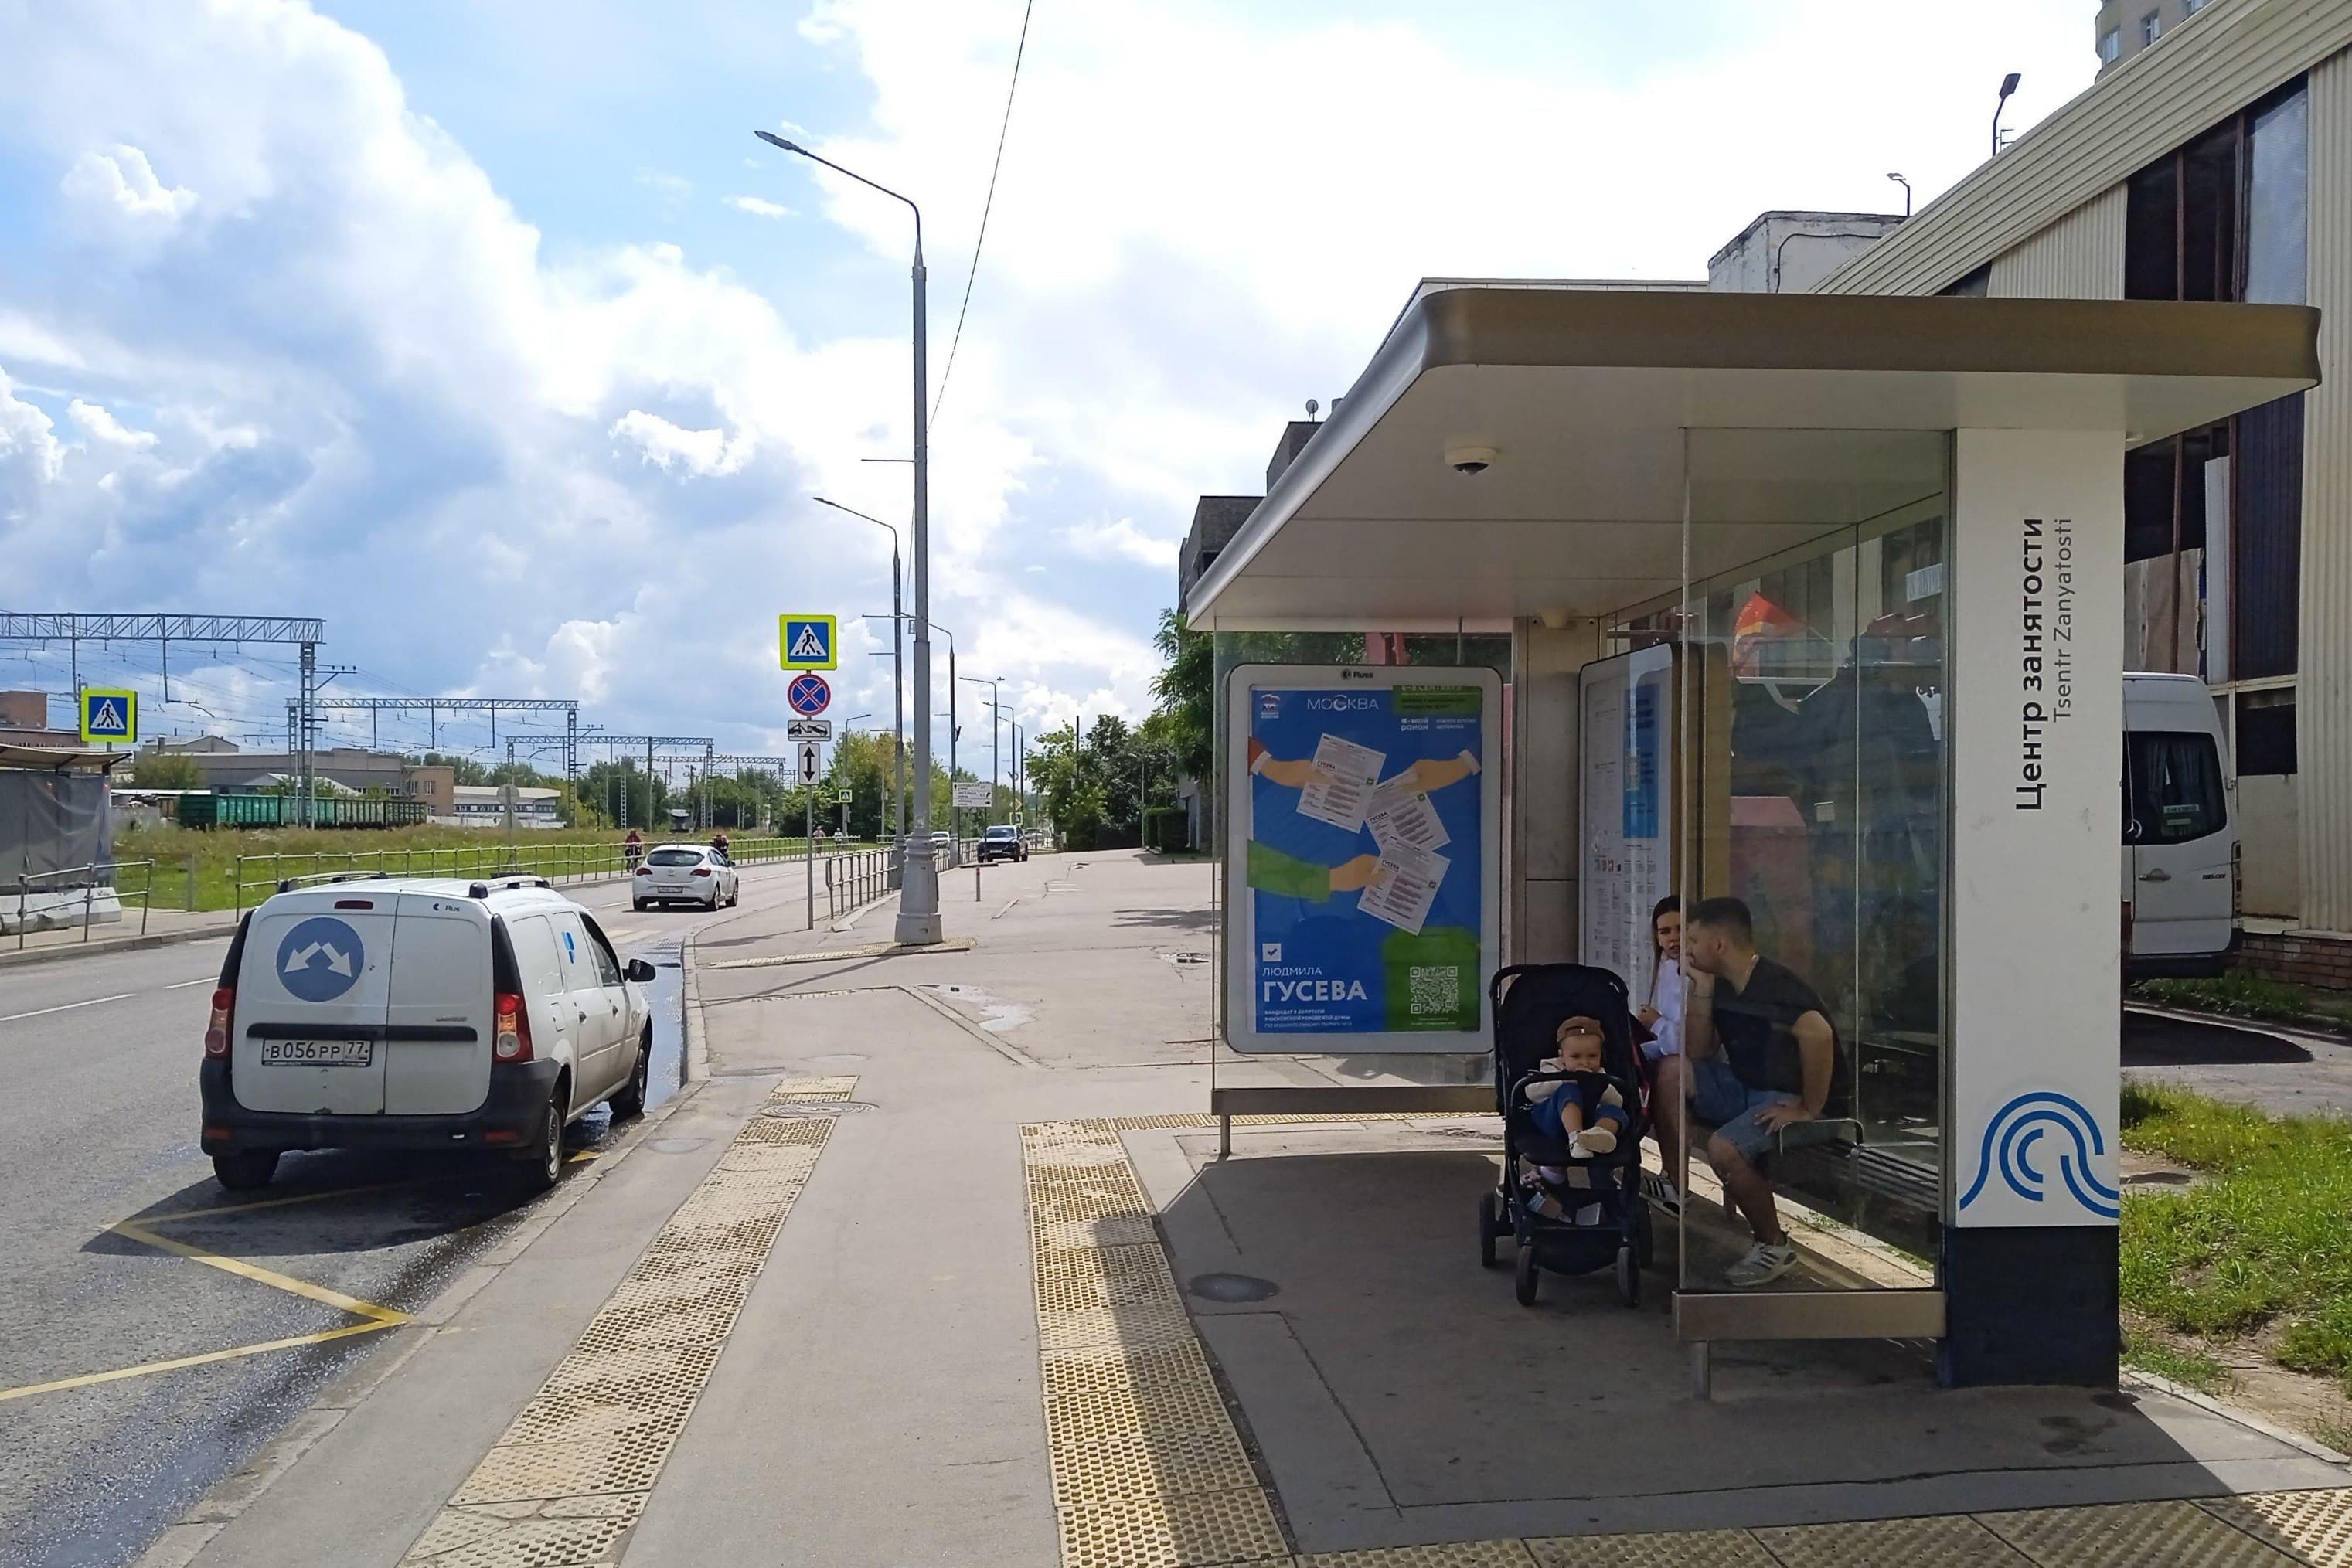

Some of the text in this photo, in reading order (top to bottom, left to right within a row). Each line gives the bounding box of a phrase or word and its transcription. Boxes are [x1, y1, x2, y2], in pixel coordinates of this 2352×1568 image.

[2054, 519, 2075, 723] Tsentr Zanyatosti
[2016, 519, 2048, 810] Центр занятости
[1307, 695, 1379, 711] МОСКВА
[1262, 967, 1322, 976] ЛЮДМИЛА
[1264, 980, 1367, 1002] ГУСЕВА
